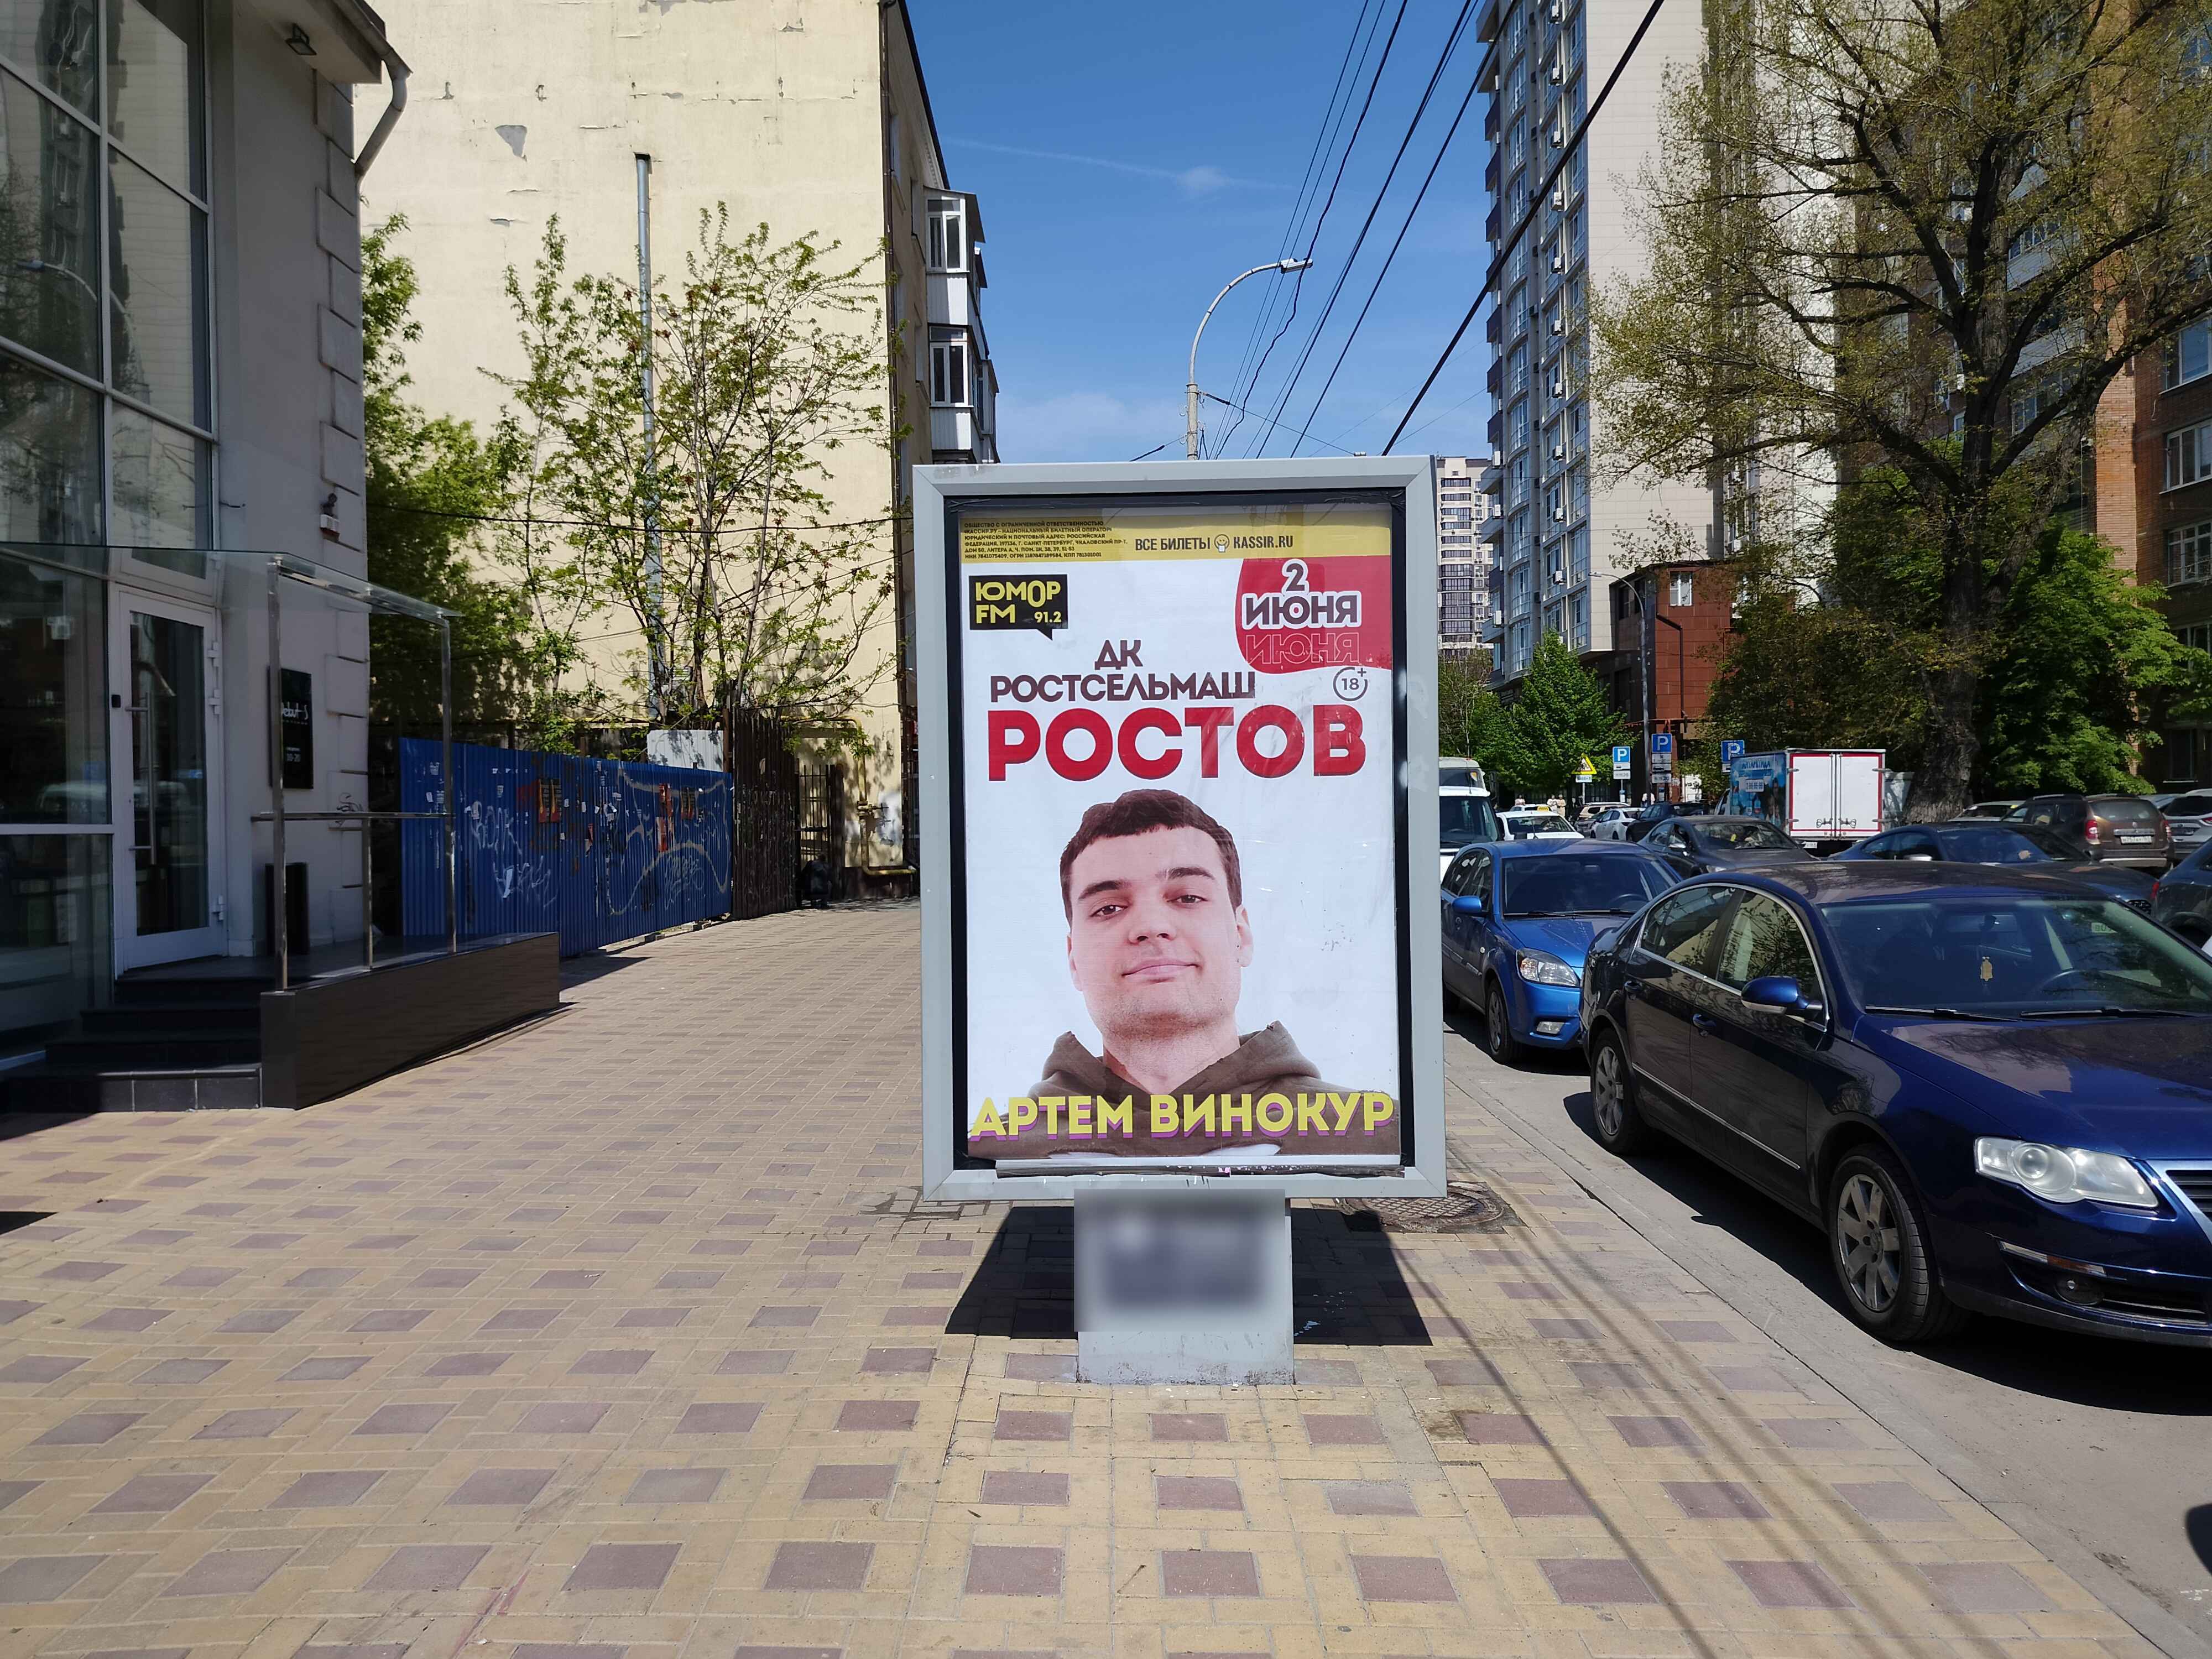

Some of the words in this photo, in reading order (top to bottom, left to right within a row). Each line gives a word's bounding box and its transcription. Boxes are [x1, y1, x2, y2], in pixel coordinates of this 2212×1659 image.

[1135, 538, 1157, 551] ВСЕ
[1160, 537, 1211, 550] БИЛЕТЫ
[1233, 535, 1293, 549] KASSIR.RU
[1285, 563, 1305, 592] 2
[975, 580, 1061, 608] ЮМОР
[1245, 594, 1358, 625] ИЮНЯ
[976, 604, 1016, 624] FM
[1034, 611, 1062, 623] 91.2
[1094, 639, 1144, 670] ДК
[1246, 632, 1360, 665] ИЮНЯ
[990, 671, 1255, 703] РОСТСЕЛЬМАШ
[987, 704, 1366, 781] РОСТОВ
[969, 1095, 1133, 1141] АРТЕМ
[1150, 1093, 1395, 1138] ВИНОКУР
